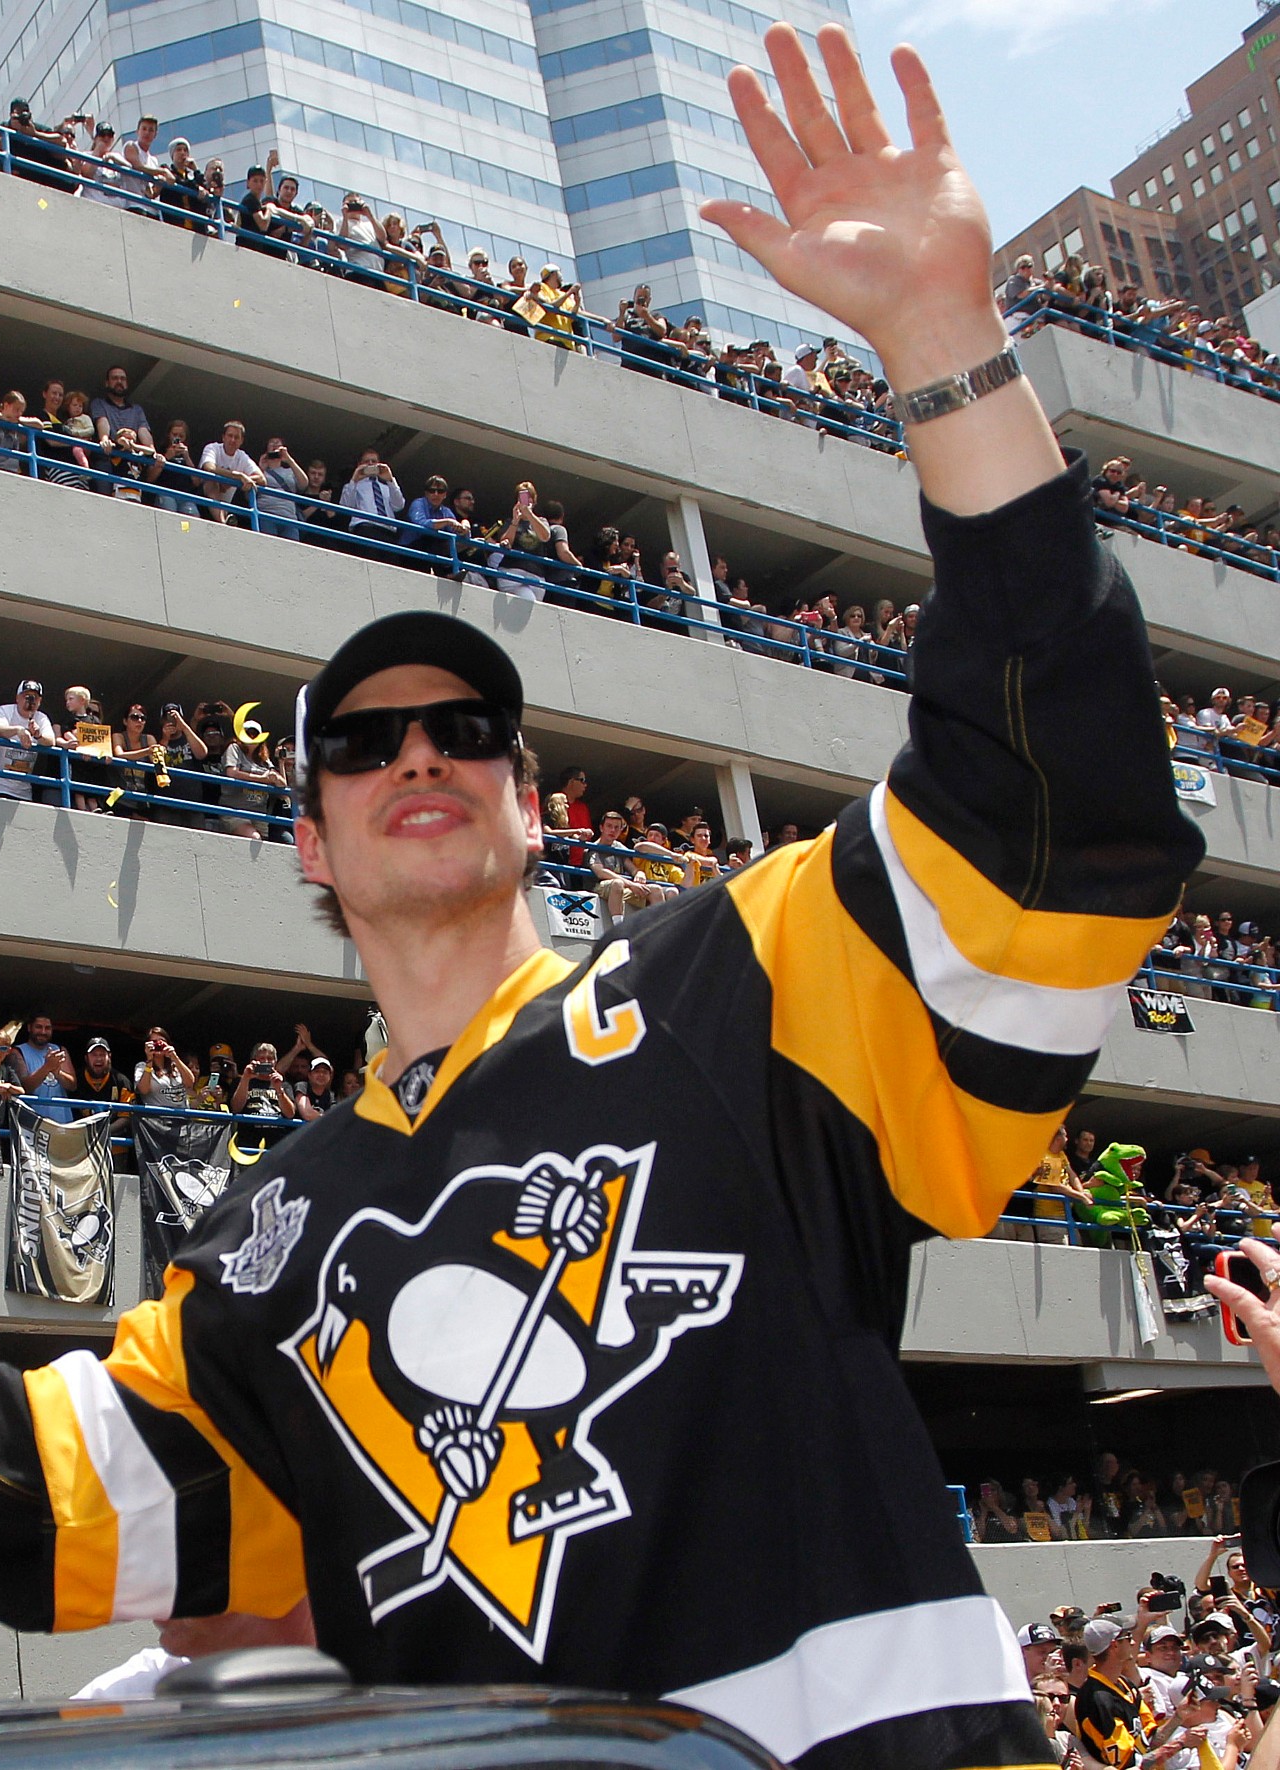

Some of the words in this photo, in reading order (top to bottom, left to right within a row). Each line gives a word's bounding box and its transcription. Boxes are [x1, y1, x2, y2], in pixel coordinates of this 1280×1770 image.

[78, 726, 97, 734] THANK
[97, 728, 109, 736] YOU
[82, 734, 105, 744] PENS!
[550, 896, 567, 907] the
[562, 938, 648, 1067] C
[37, 1129, 51, 1204] PITTSBURGH
[19, 1127, 42, 1260] PENGUINS
